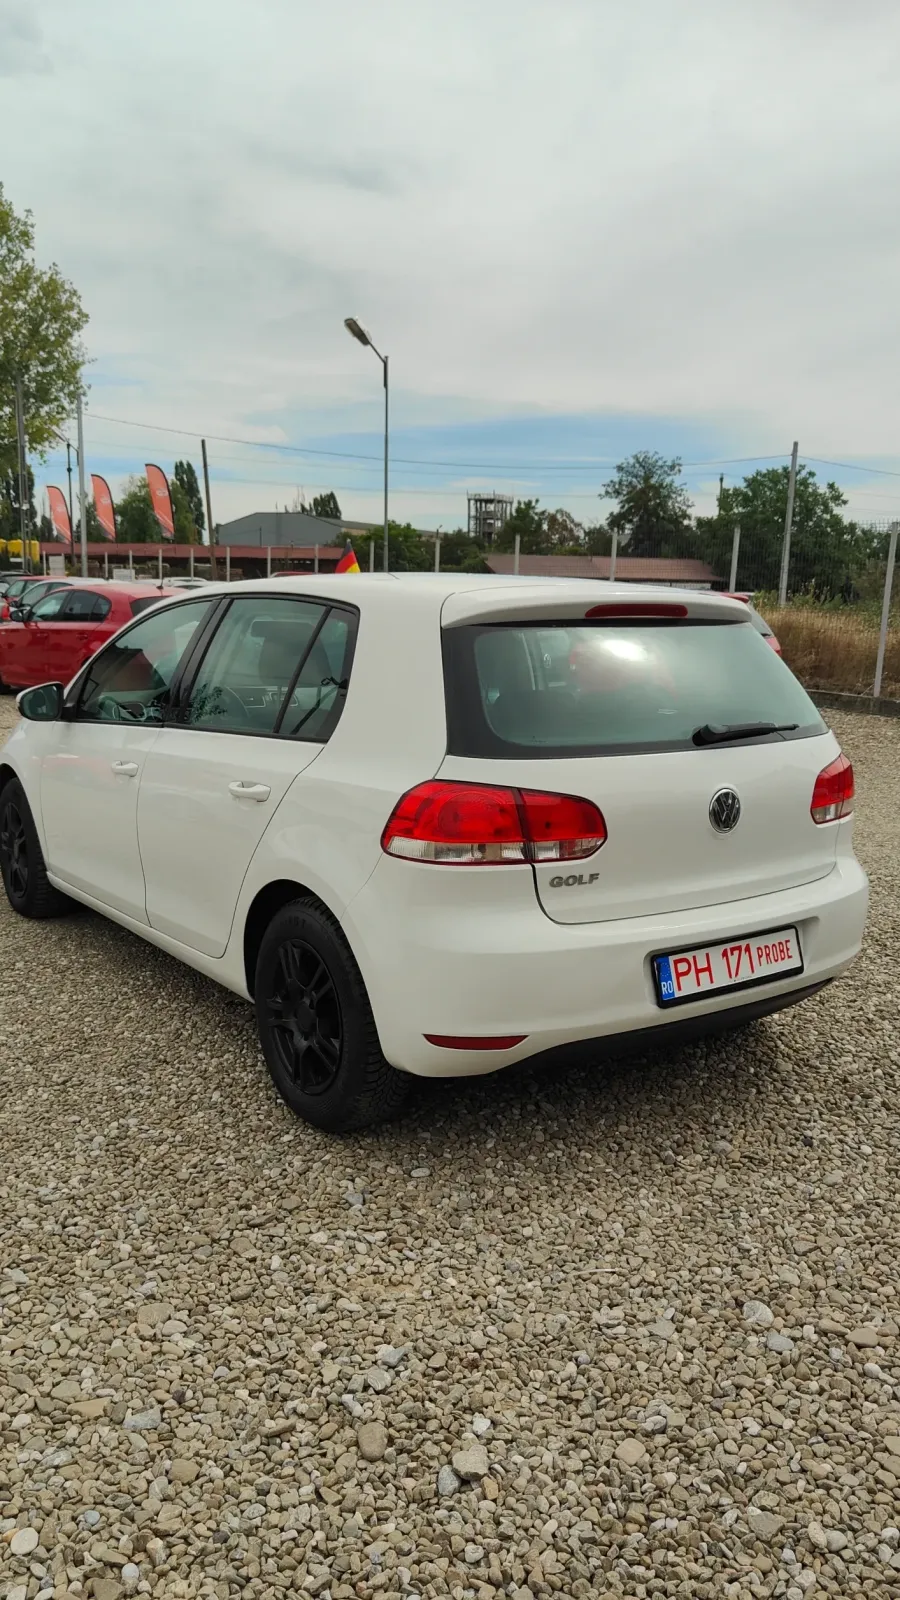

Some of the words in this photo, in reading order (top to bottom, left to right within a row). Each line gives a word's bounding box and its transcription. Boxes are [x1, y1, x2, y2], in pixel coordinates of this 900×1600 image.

[711, 789, 740, 831] VW
[549, 873, 600, 888] GOLF
[672, 952, 714, 991] PH
[721, 943, 755, 979] 171
[756, 939, 793, 966] PROBE
[661, 980, 674, 995] RO
